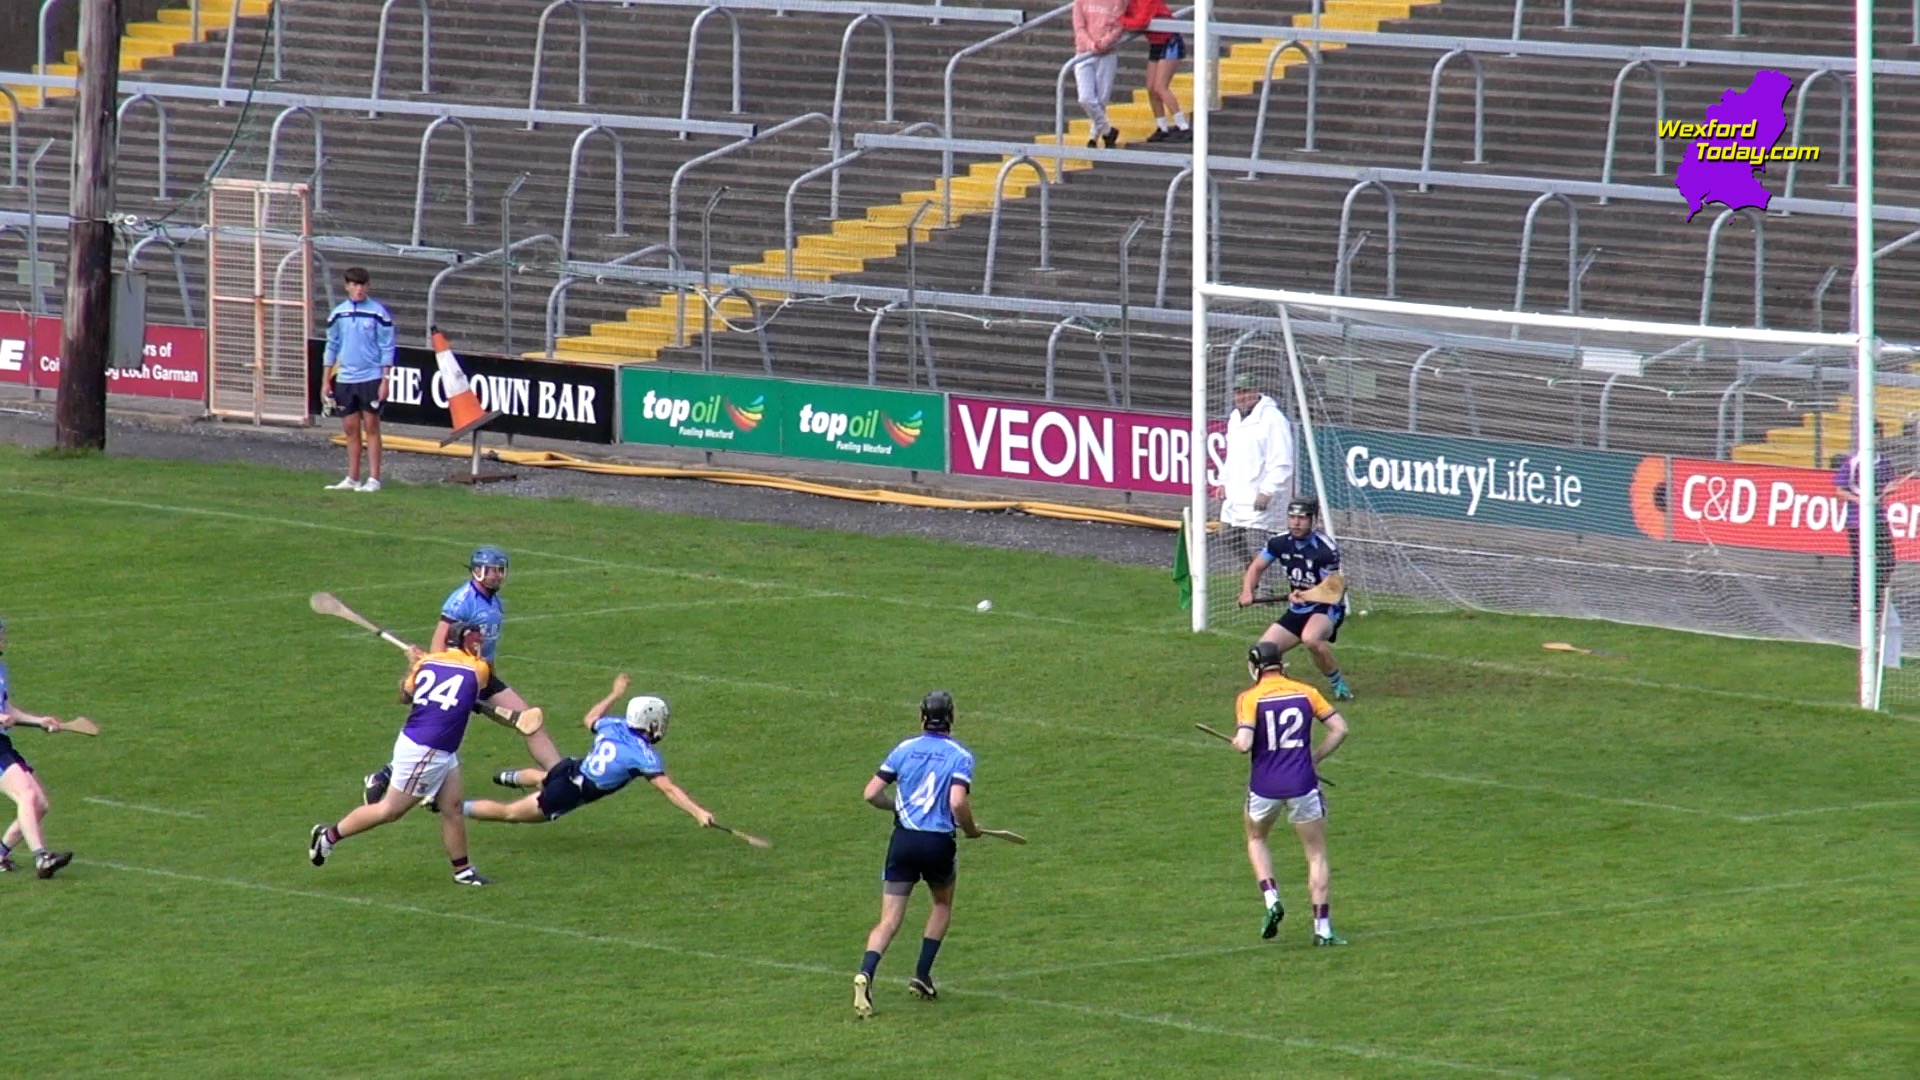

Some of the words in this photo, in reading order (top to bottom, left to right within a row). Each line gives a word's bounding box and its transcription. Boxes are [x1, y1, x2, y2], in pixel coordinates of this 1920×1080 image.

[40, 356, 60, 372] Coi
[152, 364, 199, 383] Garman
[160, 342, 172, 357] of
[384, 366, 422, 405] HE
[431, 370, 530, 417] COWN
[537, 380, 597, 424] BAR
[957, 404, 1114, 483] VEON
[1346, 446, 1582, 516] CountryLife.ie
[1682, 474, 1757, 524] C&D
[413, 669, 464, 711] 24
[1265, 707, 1304, 751] 12
[910, 771, 936, 814] 4
